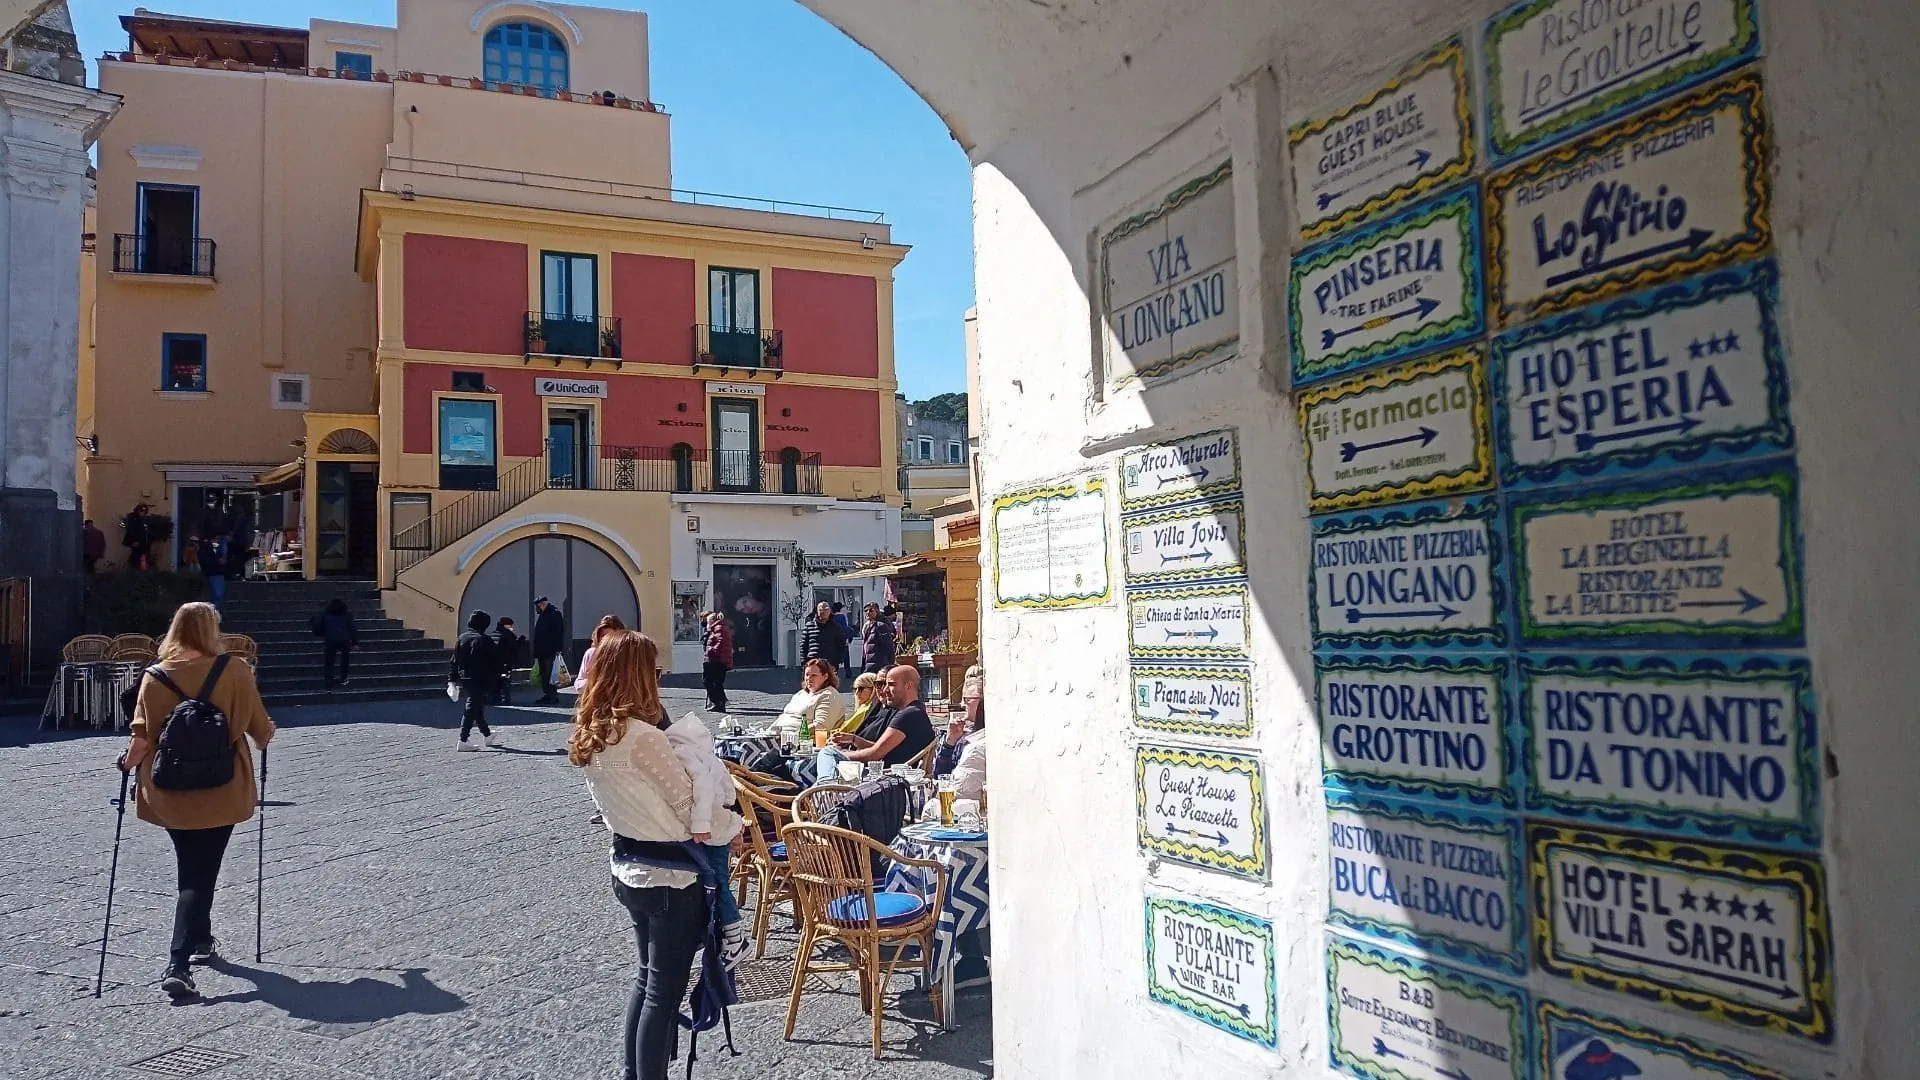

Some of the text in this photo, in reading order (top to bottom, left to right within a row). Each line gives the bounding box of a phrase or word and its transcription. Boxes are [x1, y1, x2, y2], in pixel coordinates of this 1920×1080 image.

[1520, 1, 1701, 116] Le Grottelle
[1318, 139, 1366, 175] GUEST
[1372, 112, 1426, 151] HOUSE
[1323, 92, 1418, 152] CAPRI BLUE
[1516, 117, 1715, 207] RISTORANTE PIZZERIA
[1147, 235, 1192, 285] VIA
[1314, 238, 1444, 315] PINSERIA
[1118, 270, 1225, 351] LONGANO
[1339, 278, 1423, 317] TRE FARINE
[1521, 328, 1669, 396] HOTEL
[556, 383, 600, 394] UniCredit
[717, 385, 754, 394] Kiton
[1341, 386, 1467, 433] Farmacia
[1531, 365, 1733, 441] ESPERIA
[657, 419, 703, 428] Kiton
[1138, 437, 1230, 473] Arco Naturale
[1154, 521, 1228, 548] Villa Jovis
[1610, 511, 1688, 540] HOTEL
[711, 543, 787, 553] Luisa Beccaria
[1317, 529, 1487, 568] RISTORANTE PIZZERIA
[1560, 534, 1730, 569] LA REGINELLA
[1328, 564, 1476, 607] LONGANO
[1578, 566, 1724, 593] RISTORANTE
[1146, 606, 1241, 622] Chiesa di Santa Maria
[1545, 592, 1678, 615] LA PALETTE
[1154, 681, 1240, 707] Piana delle Noci
[1328, 683, 1490, 724] RISTORANTE
[1545, 689, 1788, 746] RISTORANTE
[1332, 723, 1487, 771] GROTTINO
[1159, 768, 1236, 802] Guest House
[1547, 738, 1786, 803] DA TONINO
[1156, 795, 1238, 829] La Piazzetta
[1331, 822, 1507, 881] RISTORANTE PIZZERIA
[1334, 857, 1505, 931] BUCA di BACCO
[1560, 861, 1672, 916] HOTEL
[1164, 916, 1255, 966] RISTORANTE
[1175, 941, 1240, 984] PULALLI
[1564, 901, 1788, 981] VILLA SARAH
[1180, 967, 1236, 1000] WINE BAR
[1340, 987, 1508, 1061] SUITE ELEGANCE BELVEDERE
